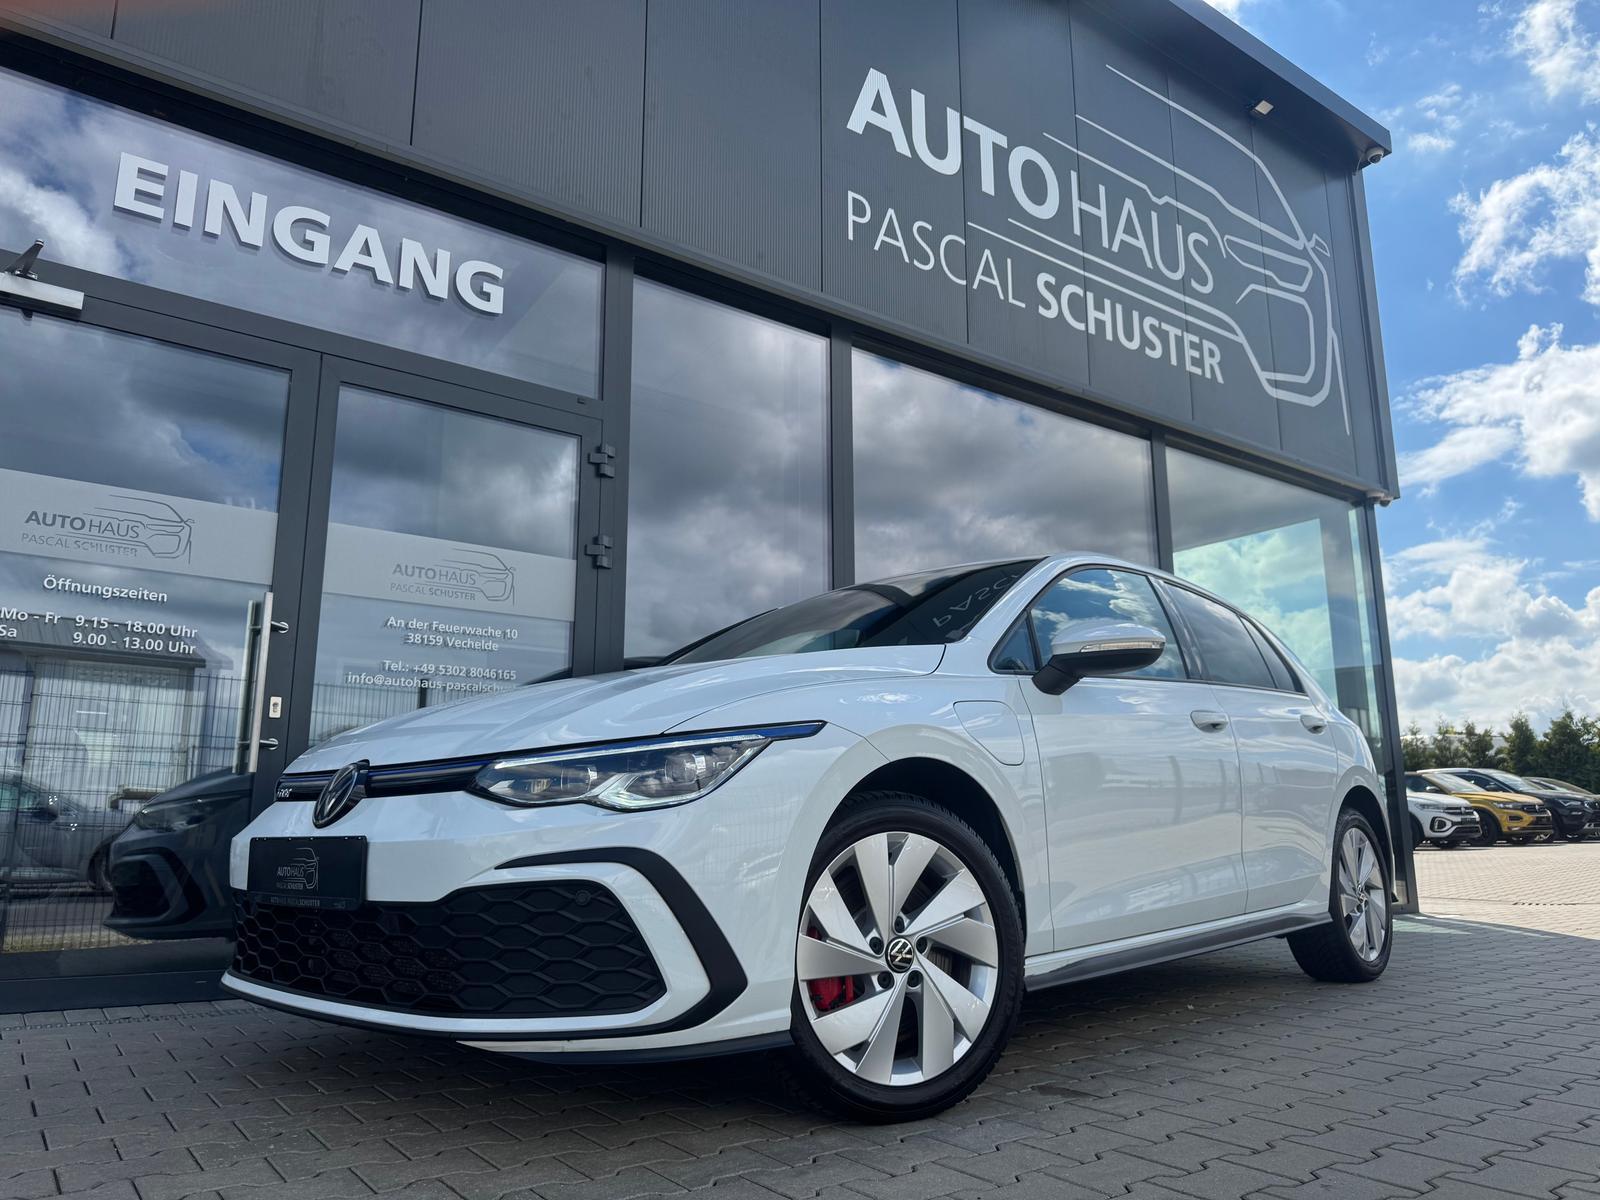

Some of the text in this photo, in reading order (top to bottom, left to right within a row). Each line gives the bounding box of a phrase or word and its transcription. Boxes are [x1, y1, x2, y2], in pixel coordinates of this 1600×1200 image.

[114, 152, 504, 315] EINGANG
[847, 190, 1224, 384] PASCAL SCHUSTER
[21, 532, 70, 549] PASCAL
[43, 575, 168, 602] Öffnungszeiten
[390, 582, 476, 601] PASCAL SCHUSTER
[0, 606, 29, 621] Mo
[45, 611, 61, 624] Fr
[75, 614, 109, 629] 9.15
[125, 620, 165, 635] 18.00
[170, 625, 198, 638] Uhr
[387, 616, 518, 639] An der Feuerwache 10
[0, 624, 17, 638] Sa
[73, 632, 107, 645] 9.00
[123, 637, 164, 651] 13.00
[168, 641, 196, 654] Uhr
[407, 632, 499, 651] 38159 Vechelde
[384, 660, 516, 680] Tel.: +49 5302 8046165
